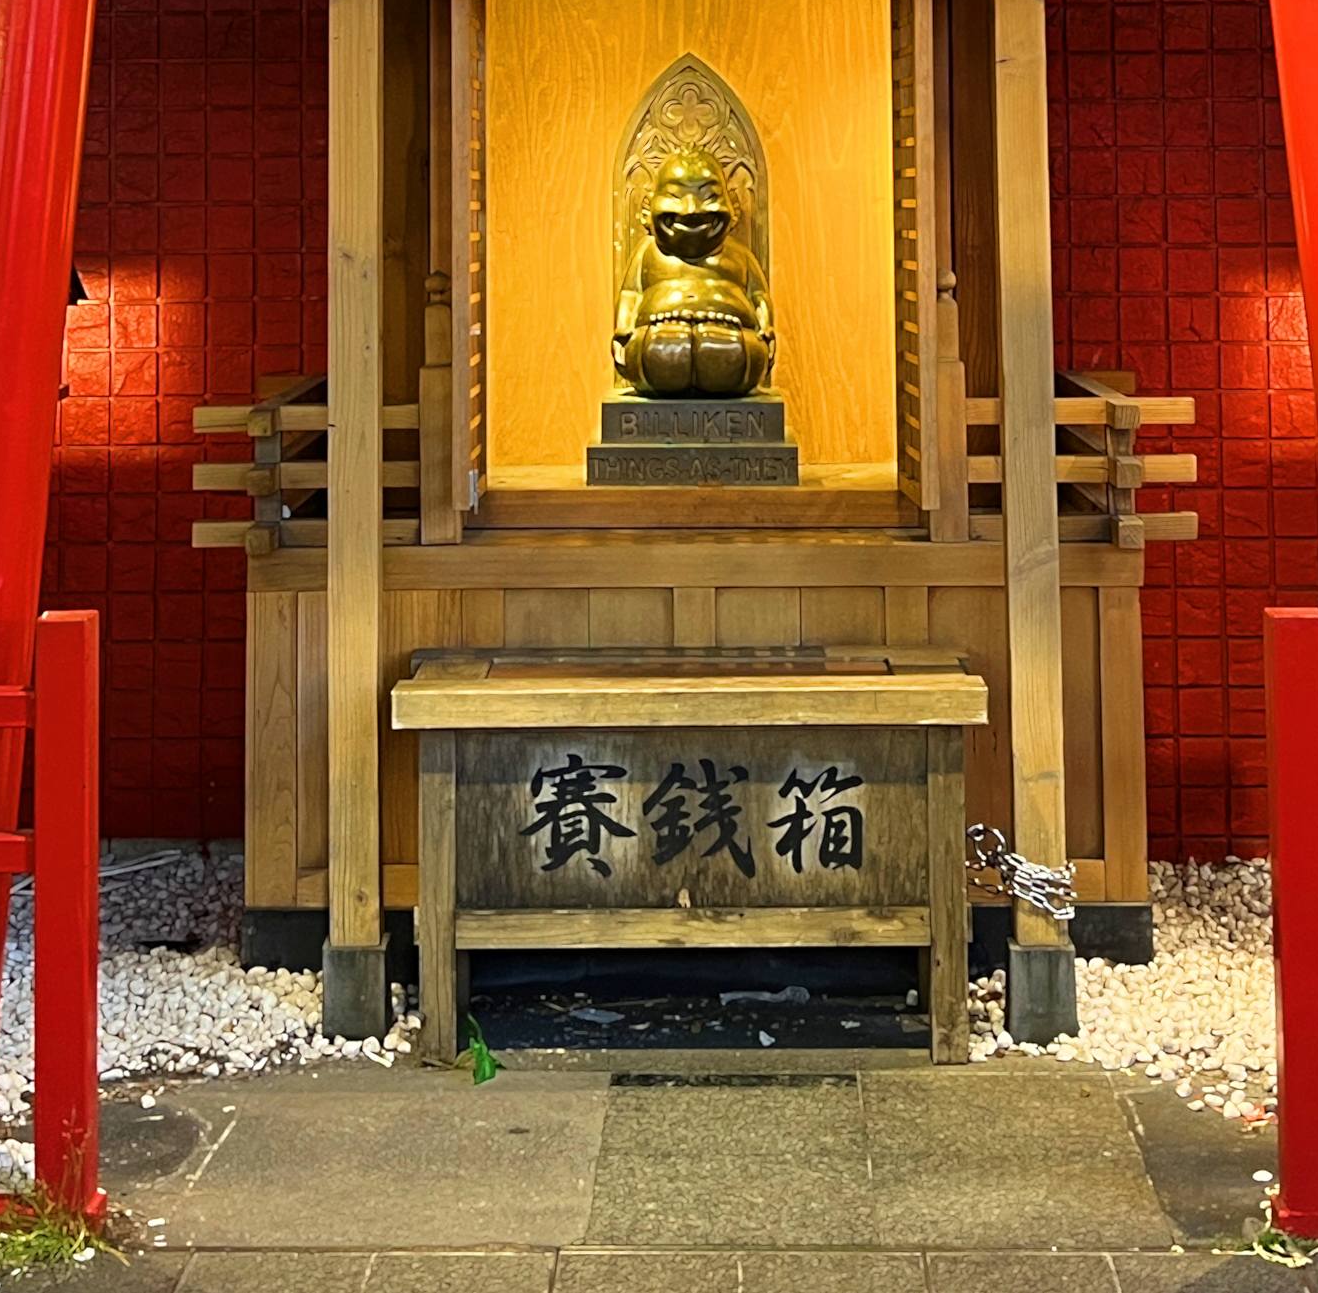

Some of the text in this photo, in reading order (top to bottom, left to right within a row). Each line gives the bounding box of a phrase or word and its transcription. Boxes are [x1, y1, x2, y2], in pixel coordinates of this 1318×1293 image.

[620, 410, 766, 438] BILLIKEN
[591, 456, 680, 481] THINGS
[729, 456, 795, 482] THEY
[518, 753, 867, 880] 賽銭箱
